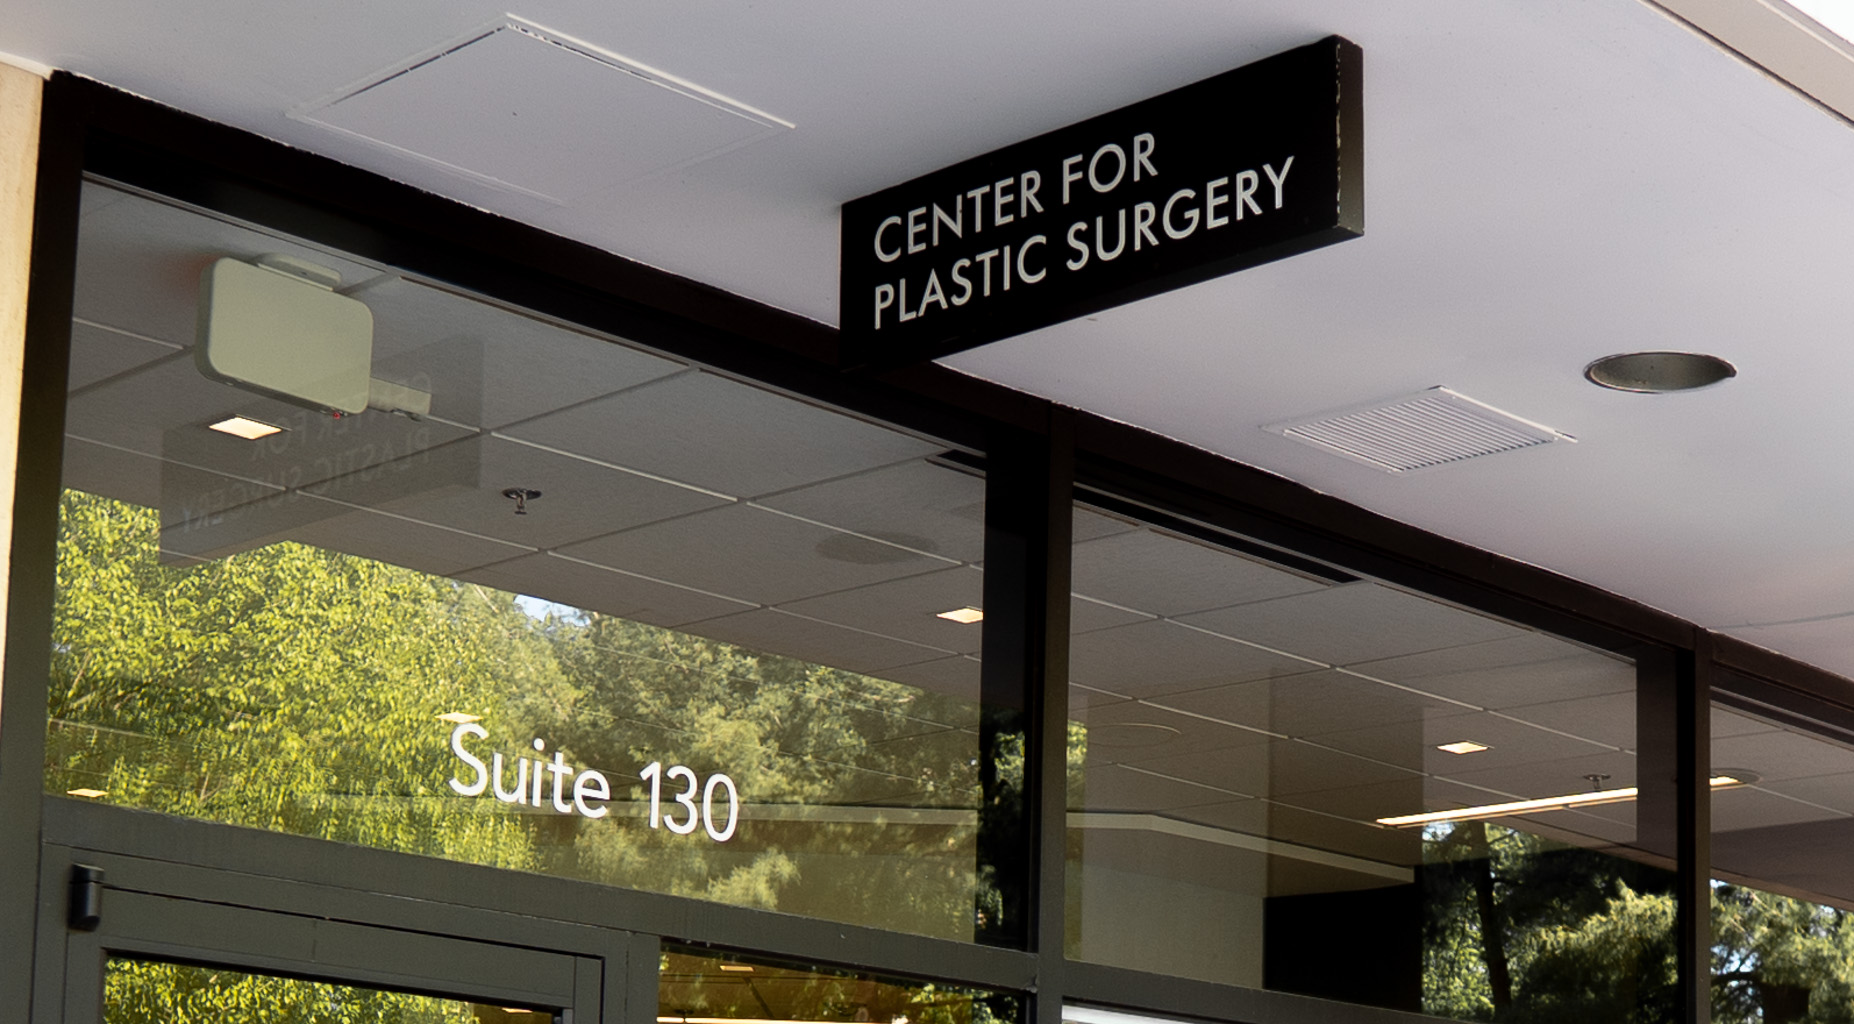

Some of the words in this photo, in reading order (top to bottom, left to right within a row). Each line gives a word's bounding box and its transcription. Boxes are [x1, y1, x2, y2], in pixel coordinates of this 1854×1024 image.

[874, 170, 1044, 263] CENTER
[1062, 133, 1159, 204] FOR
[874, 235, 1047, 330] PLASTIC
[1066, 156, 1295, 271] SURGERY
[449, 723, 611, 819] Suite
[639, 761, 739, 842] 130
